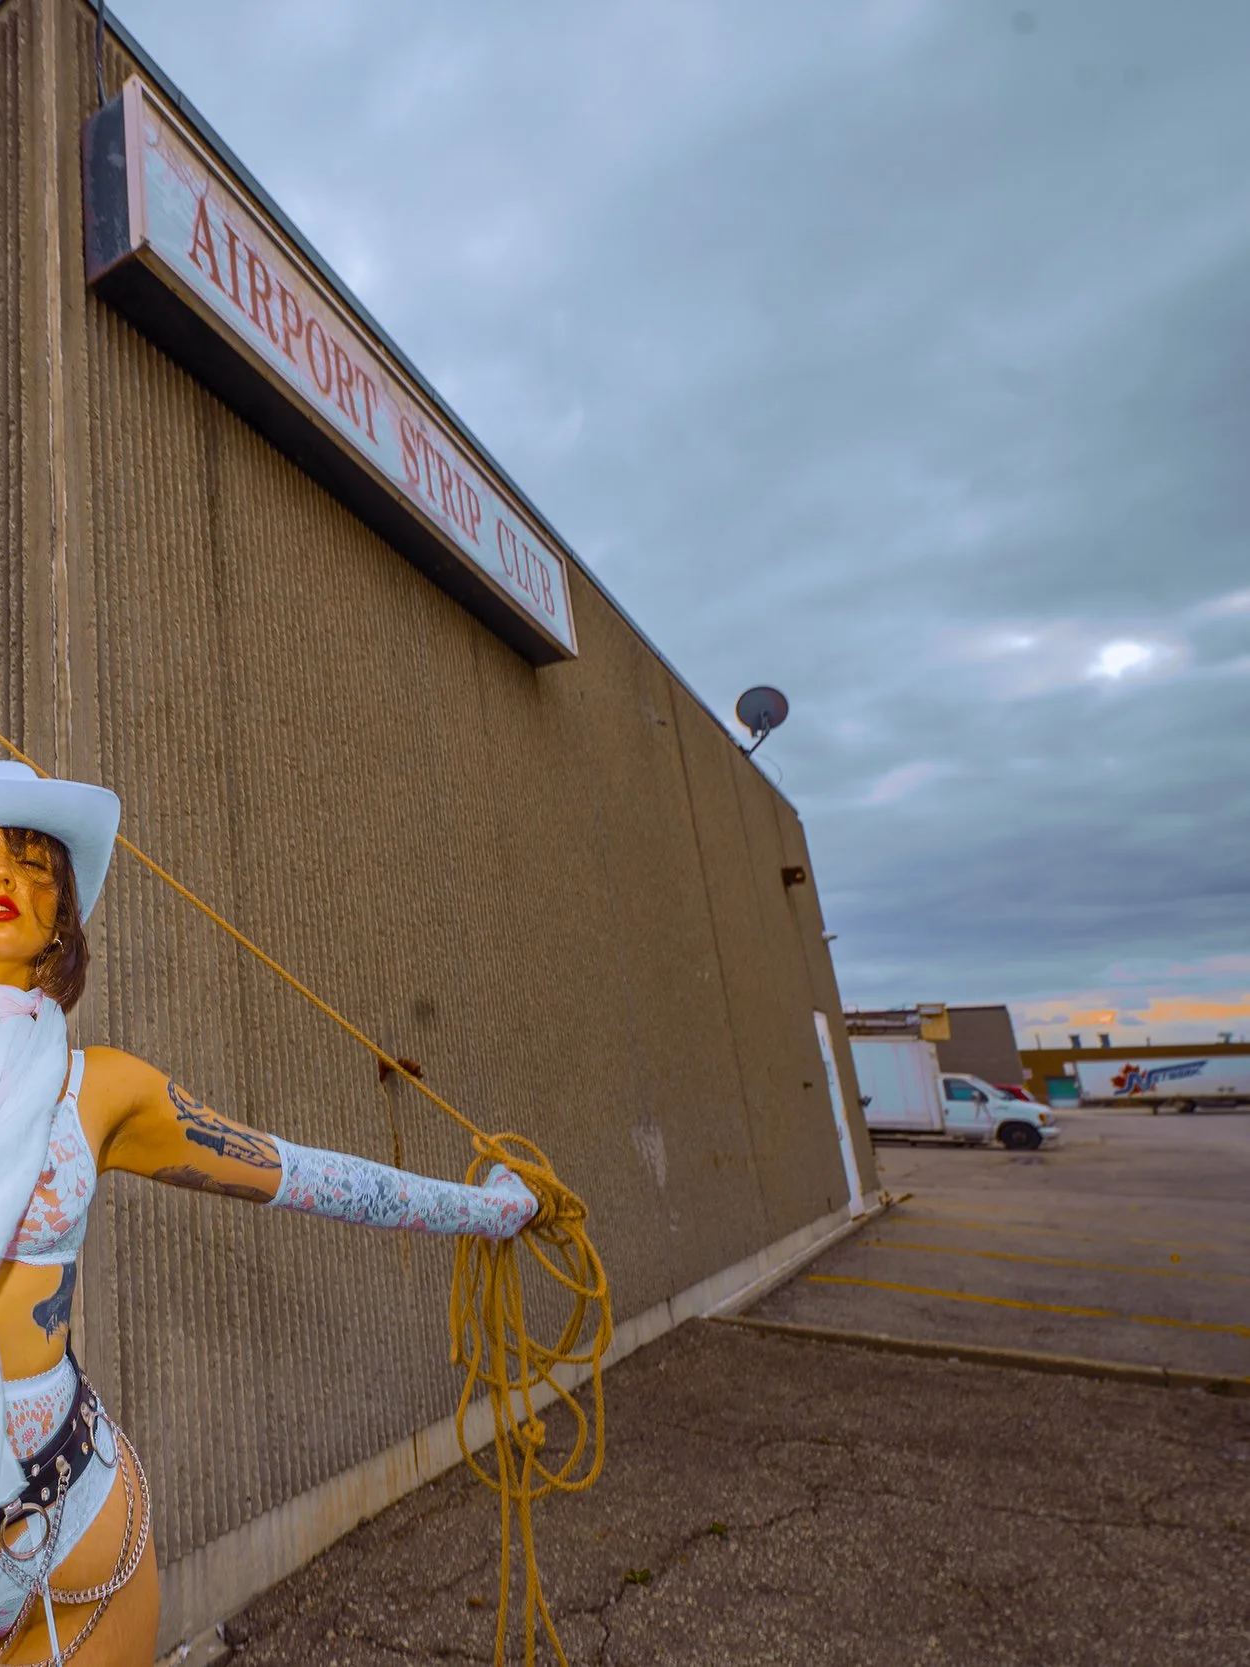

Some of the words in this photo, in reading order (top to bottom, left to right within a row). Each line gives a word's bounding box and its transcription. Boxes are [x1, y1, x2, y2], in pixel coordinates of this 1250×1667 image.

[188, 196, 379, 447] AIRPORT
[399, 415, 482, 548] STRIP
[496, 516, 556, 618] CLUB
